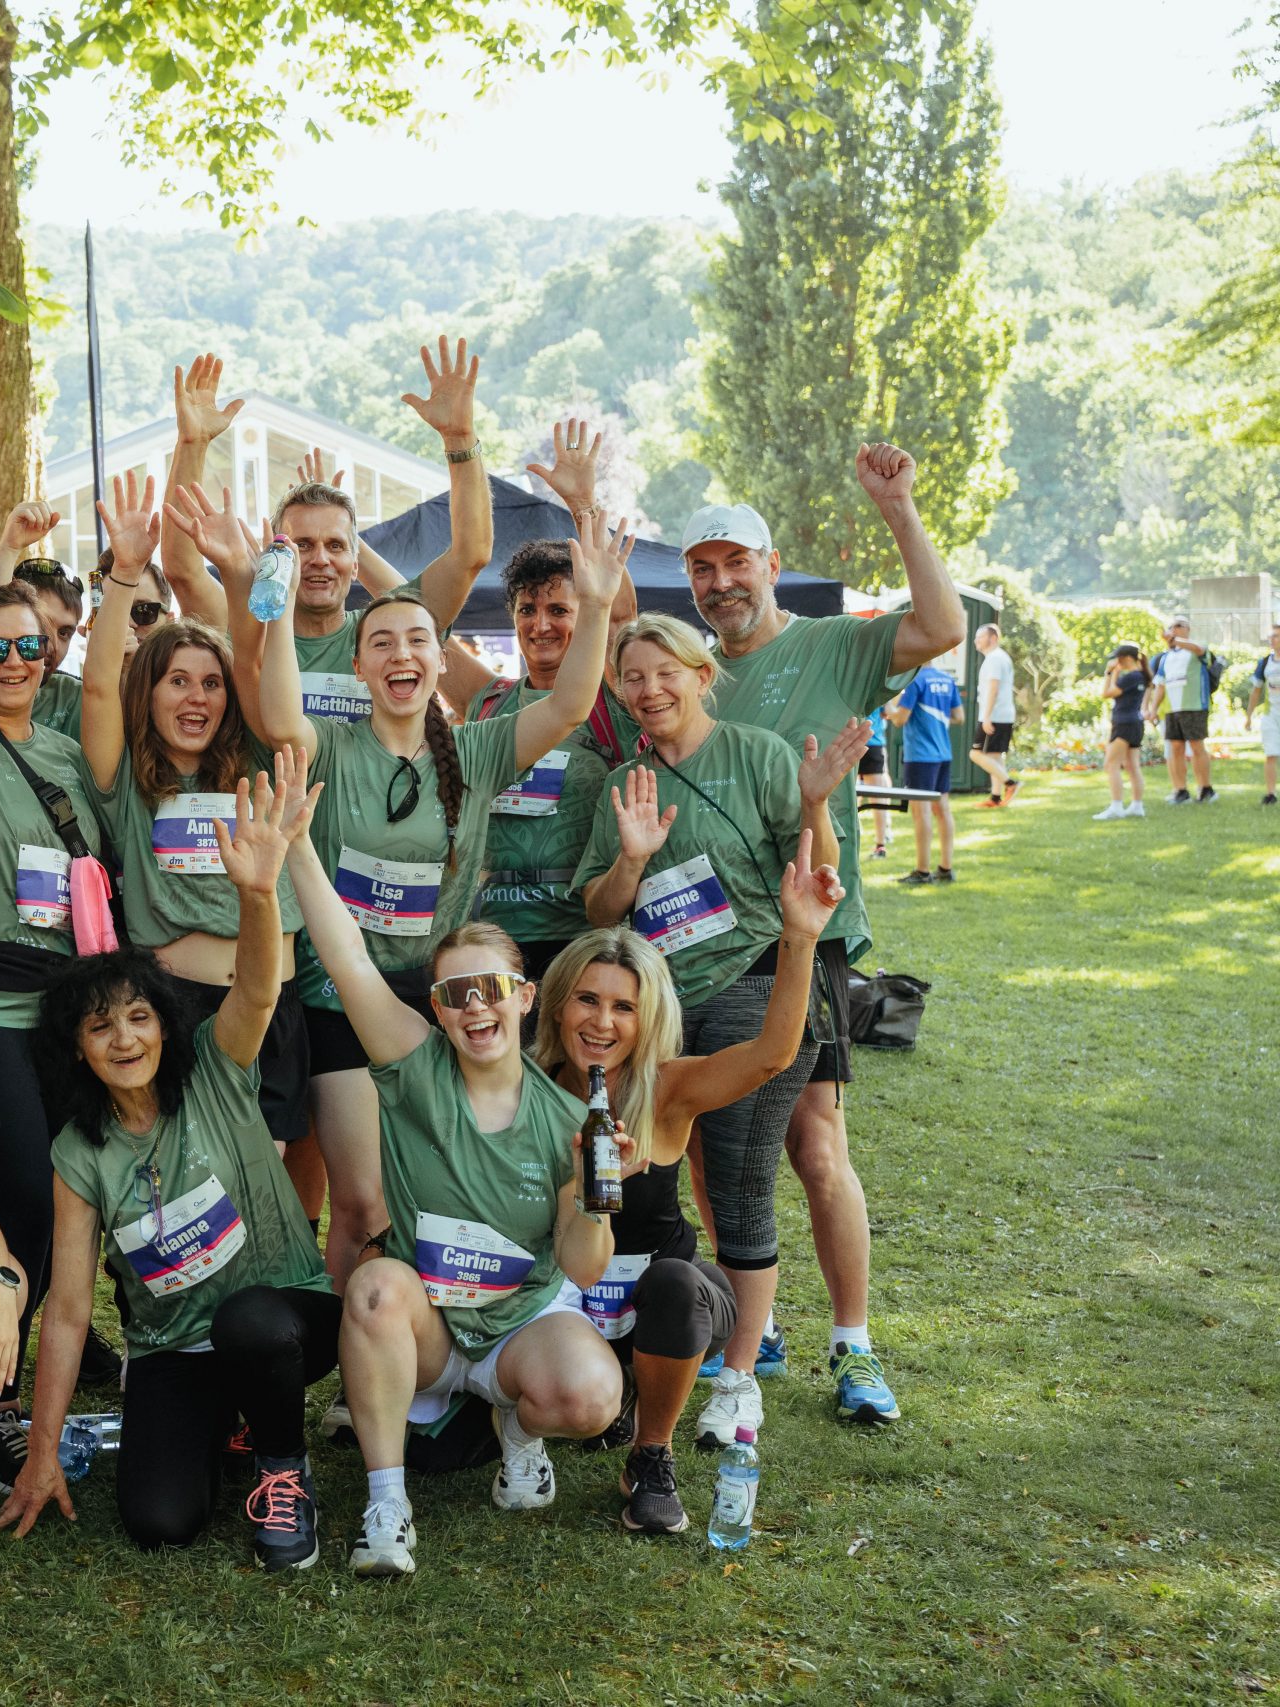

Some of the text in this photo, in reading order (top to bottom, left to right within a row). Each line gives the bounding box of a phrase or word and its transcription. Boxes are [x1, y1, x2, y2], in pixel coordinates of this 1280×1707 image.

[306, 695, 373, 715] Matthias
[506, 783, 523, 792] 856
[186, 818, 228, 835] Ann
[196, 839, 219, 847] 3870
[169, 856, 184, 865] dm
[371, 880, 404, 901] Lisa
[373, 899, 396, 911] 3873
[643, 889, 700, 920] Yvonne
[32, 909, 47, 918] dm
[665, 911, 687, 926] 3875
[154, 1219, 210, 1257] Hanne
[179, 1240, 202, 1260] 3867
[442, 1246, 502, 1273] Carina
[164, 1275, 179, 1287] dm
[456, 1271, 481, 1283] 3865
[425, 1284, 439, 1296] dm
[583, 1285, 625, 1300] drun
